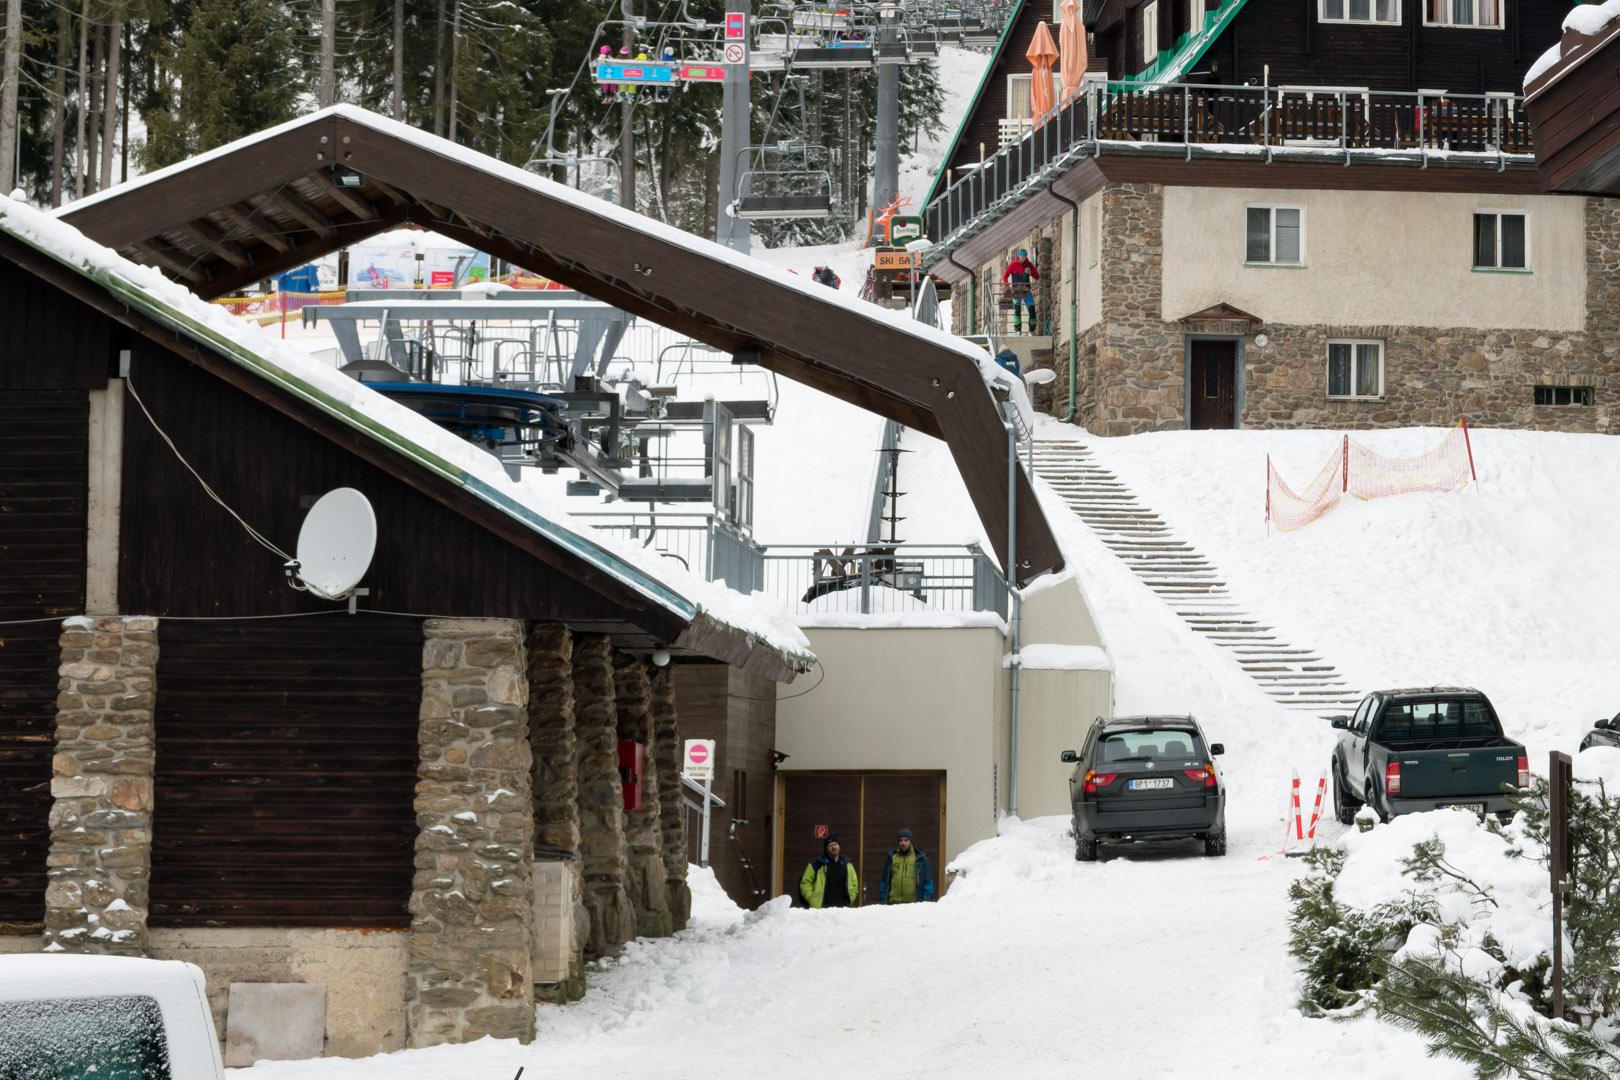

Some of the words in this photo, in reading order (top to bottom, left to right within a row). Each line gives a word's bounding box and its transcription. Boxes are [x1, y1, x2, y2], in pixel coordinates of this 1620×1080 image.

[880, 257, 894, 265] SKI
[899, 256, 916, 265] BA
[1153, 780, 1170, 788] 1737
